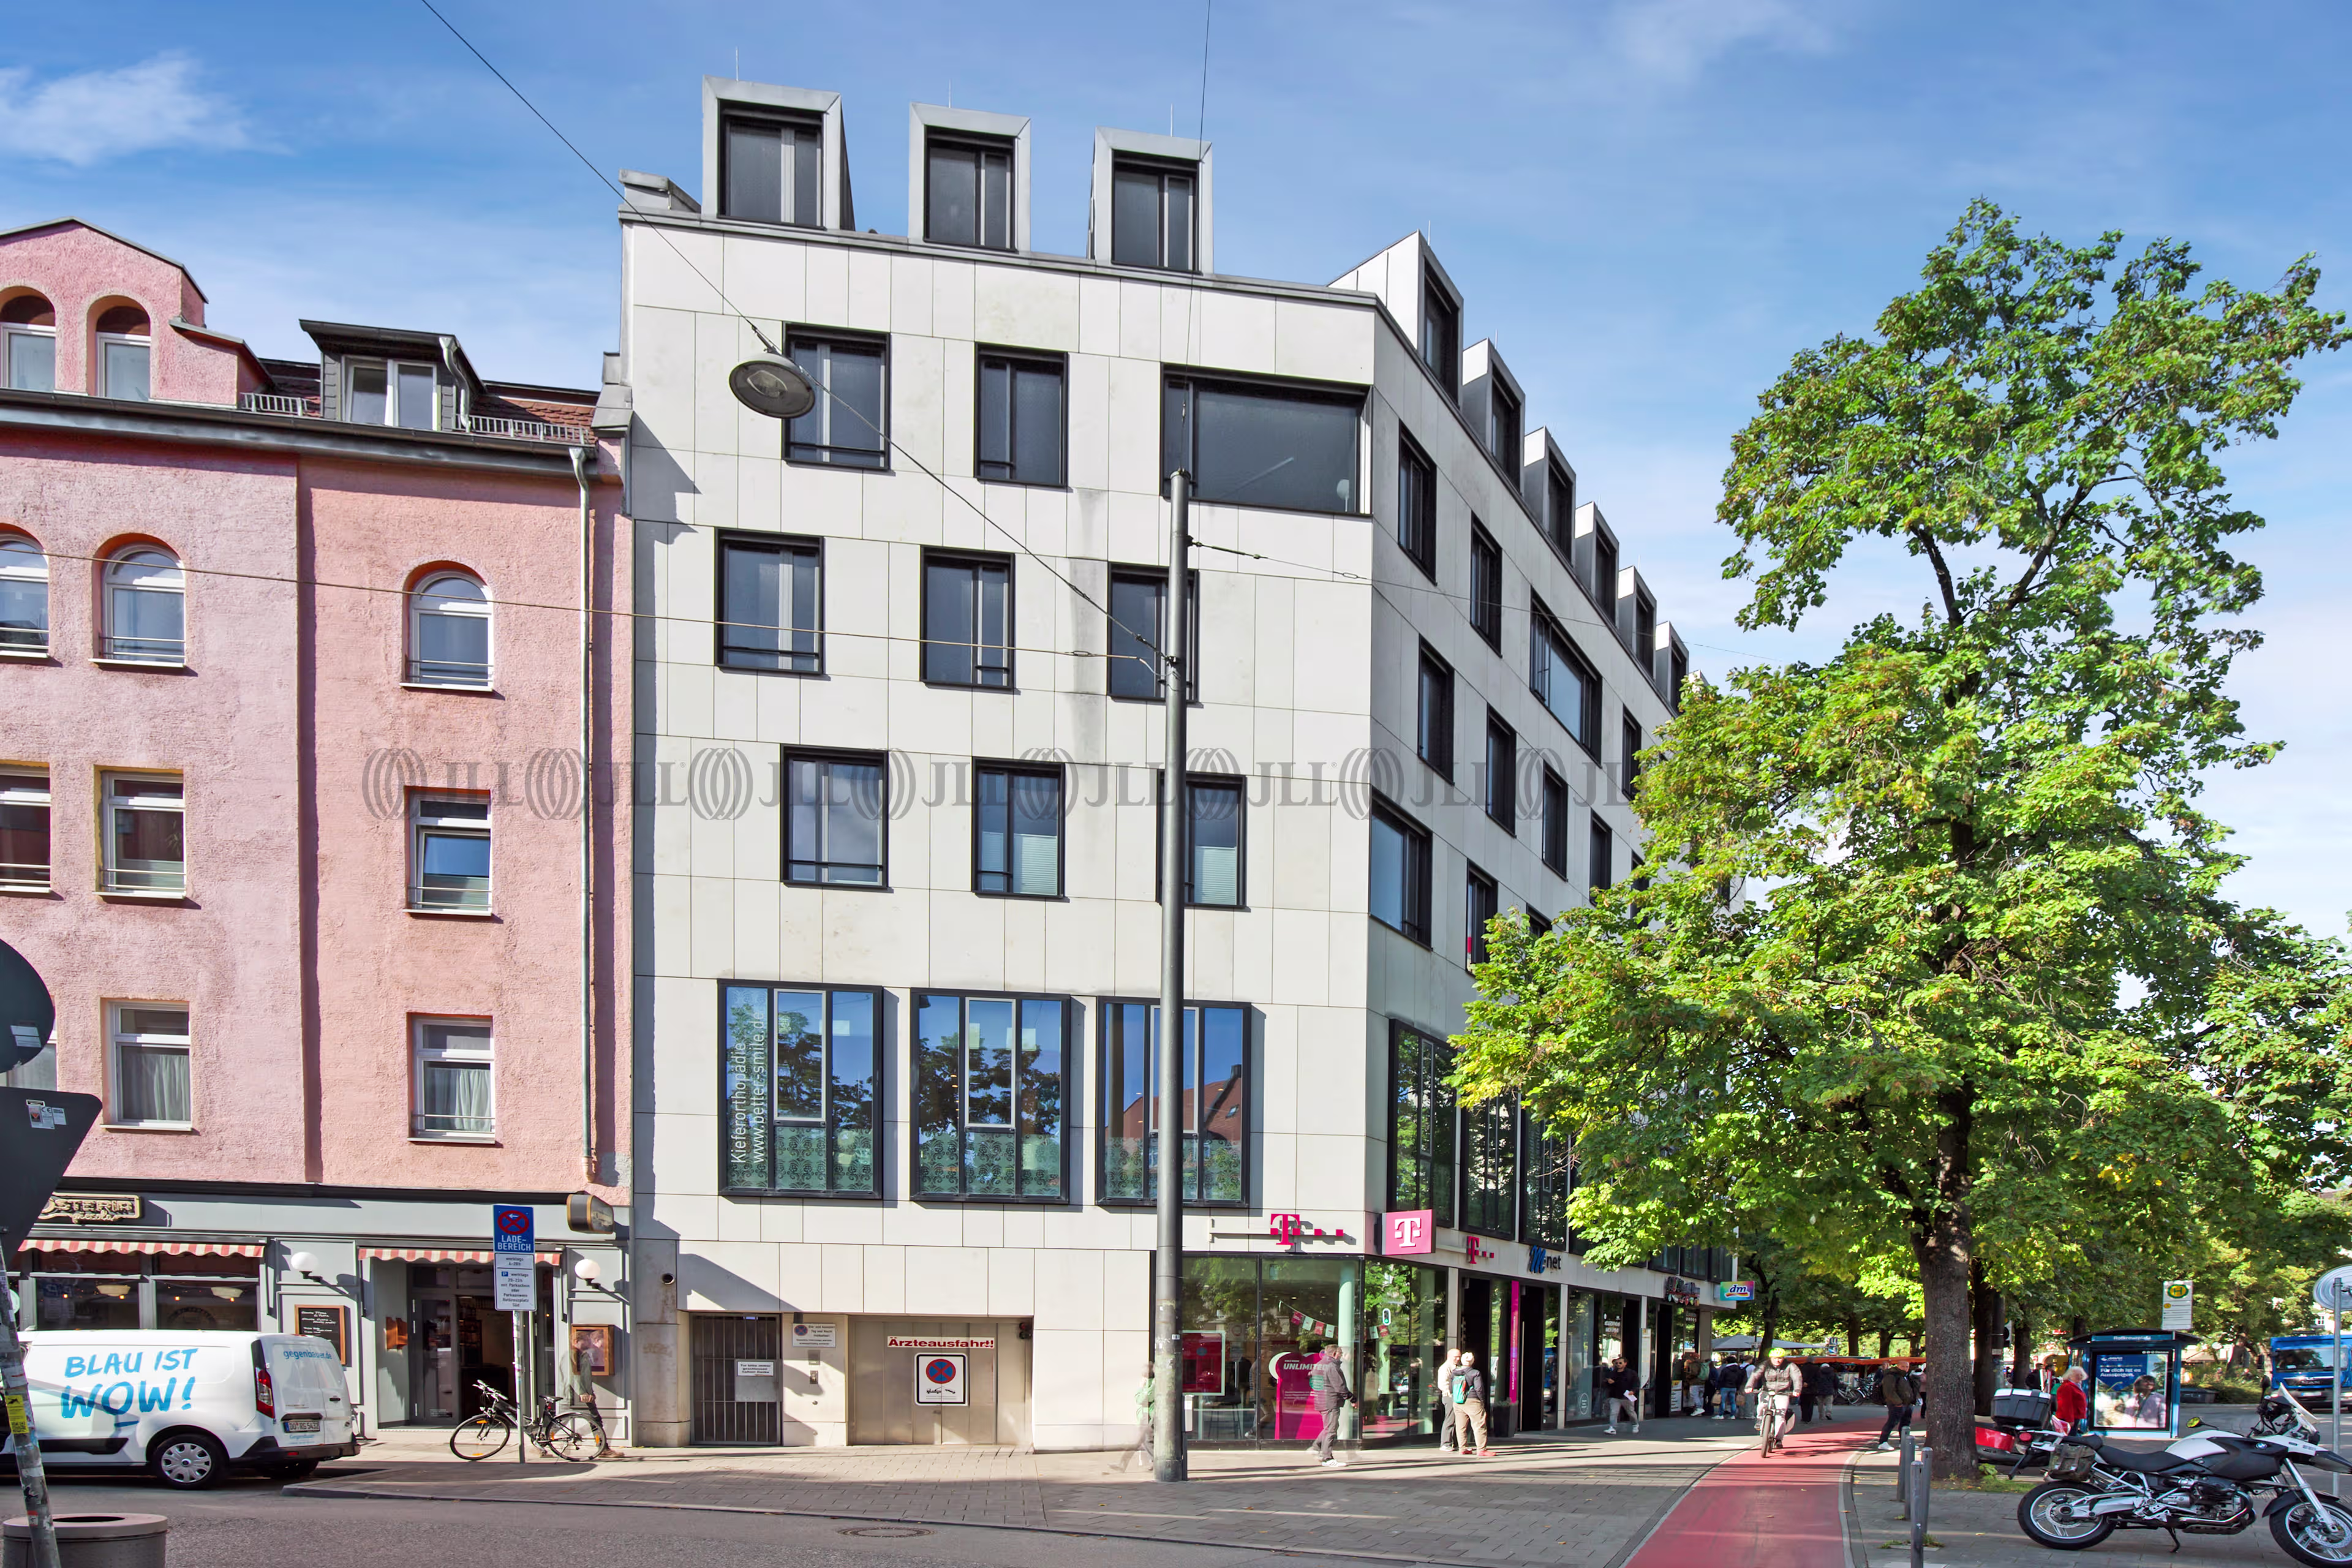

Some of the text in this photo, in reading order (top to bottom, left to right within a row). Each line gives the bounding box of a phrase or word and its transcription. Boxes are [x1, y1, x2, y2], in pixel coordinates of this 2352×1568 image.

[749, 1011, 765, 1163] www.better-smile.de
[731, 1041, 747, 1163] Kieferorthopädie
[501, 1235, 527, 1243] LADE-
[1395, 1217, 1421, 1247] T
[497, 1242, 531, 1251] BEREICH
[1730, 1283, 1747, 1293] dm
[2173, 1286, 2183, 1295] H
[888, 1337, 993, 1348] Ärzteausfahrt!
[64, 1348, 199, 1378] BLAU IST
[61, 1376, 195, 1419] WOW!
